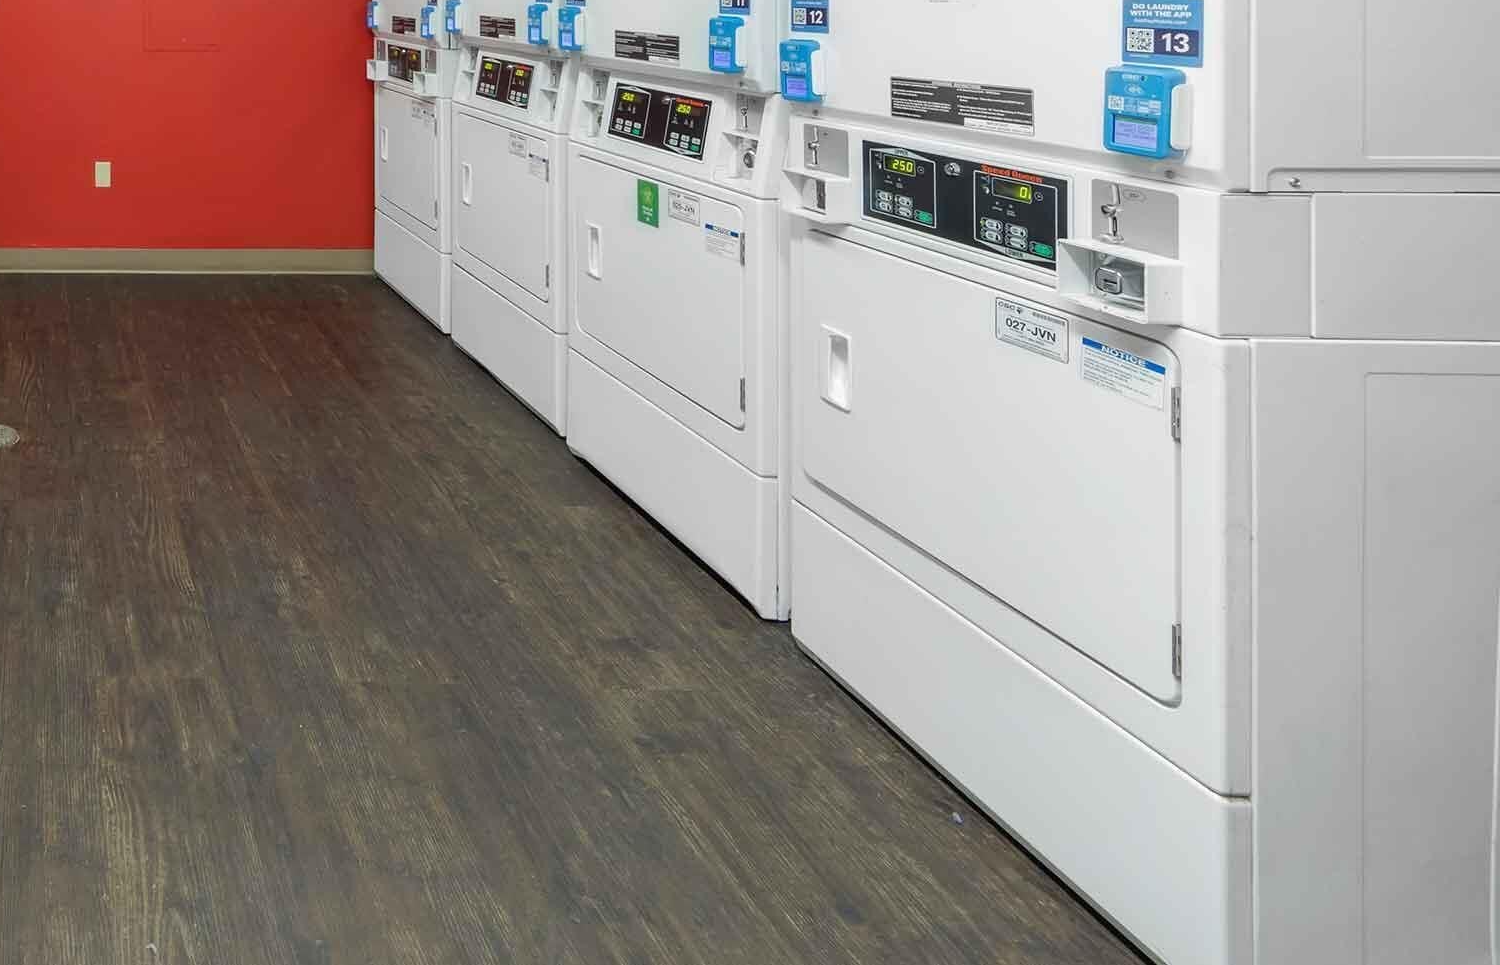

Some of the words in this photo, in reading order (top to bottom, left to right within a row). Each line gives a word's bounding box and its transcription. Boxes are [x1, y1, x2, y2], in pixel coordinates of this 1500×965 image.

[1130, 9, 1151, 17] WITH
[1147, 3, 1188, 11] LAUNDRY
[809, 10, 824, 24] 12
[1161, 32, 1190, 53] 13
[892, 159, 914, 173] 250
[981, 164, 1010, 176] Speed
[1011, 169, 1043, 183] Queen
[1005, 317, 1056, 343] 027-JVN
[1101, 345, 1147, 367] NOTICE
